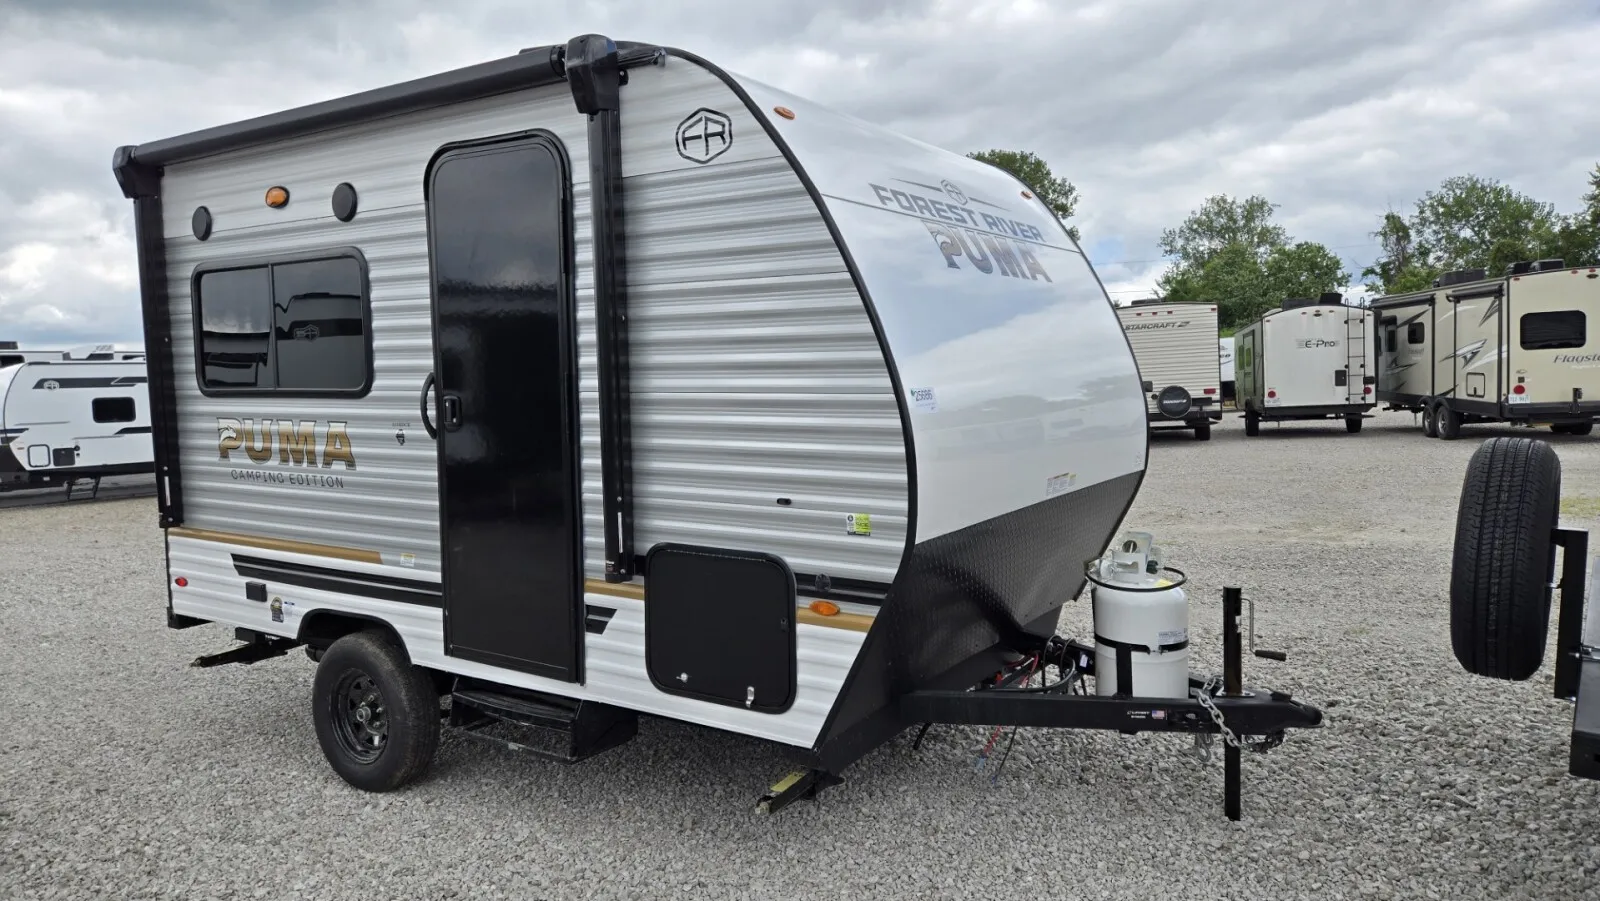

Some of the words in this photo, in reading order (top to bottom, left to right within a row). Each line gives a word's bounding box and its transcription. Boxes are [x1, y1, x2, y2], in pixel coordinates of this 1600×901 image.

[868, 183, 979, 227] FOREST
[980, 212, 1046, 242] RIVER
[921, 220, 1052, 283] PUMA
[1124, 323, 1177, 331] STARCRAFT
[1305, 340, 1336, 348] E-Pro
[216, 417, 357, 470] PUMA
[231, 470, 285, 483] CAMPING
[289, 474, 344, 488] EDITION
